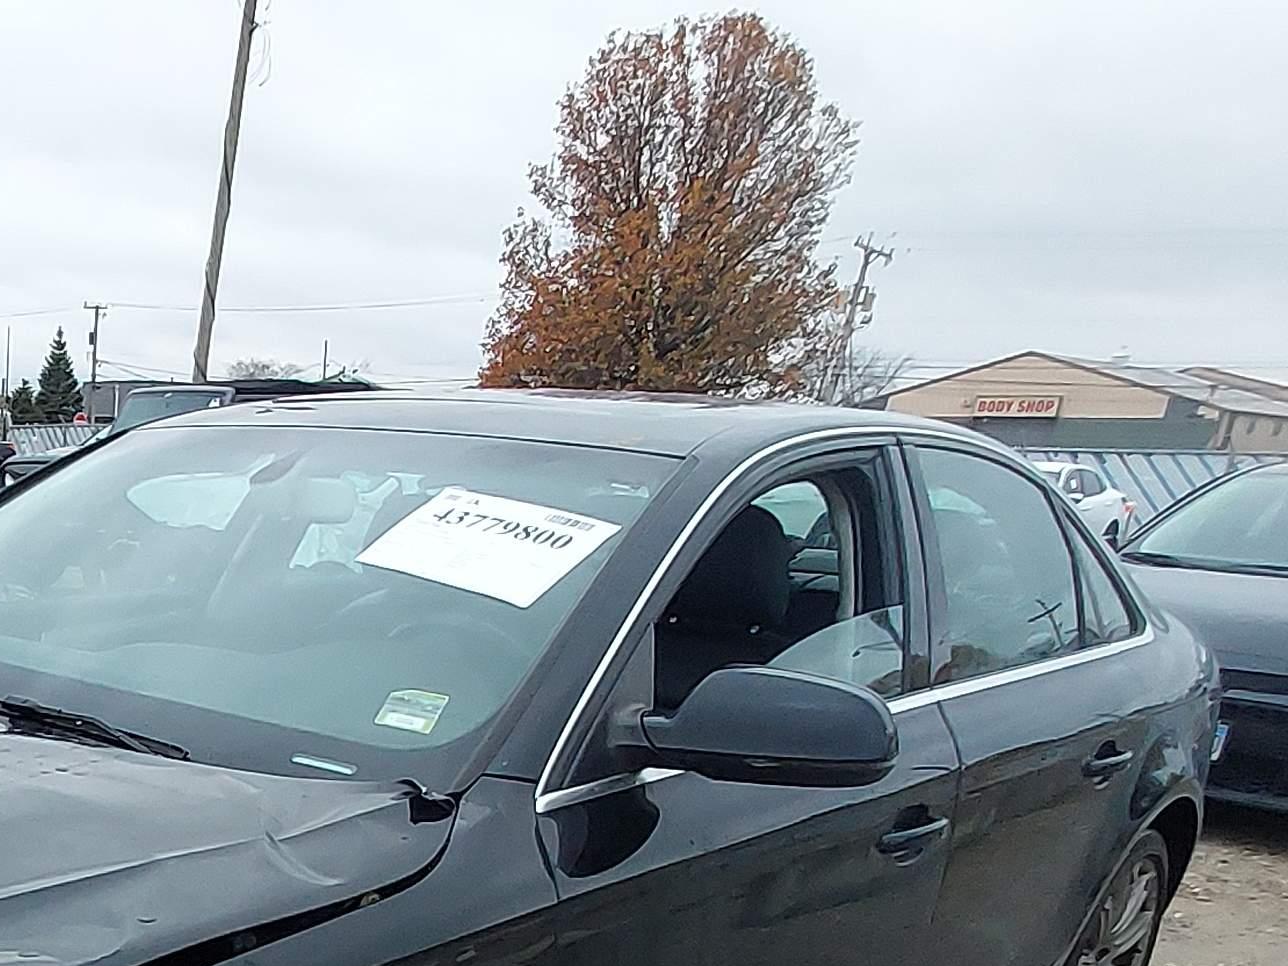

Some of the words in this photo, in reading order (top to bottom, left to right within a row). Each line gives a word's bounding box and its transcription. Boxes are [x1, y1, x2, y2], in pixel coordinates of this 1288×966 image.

[977, 400, 1014, 413] BODY
[1016, 399, 1056, 413] SHOP
[432, 507, 574, 550] 43779800
